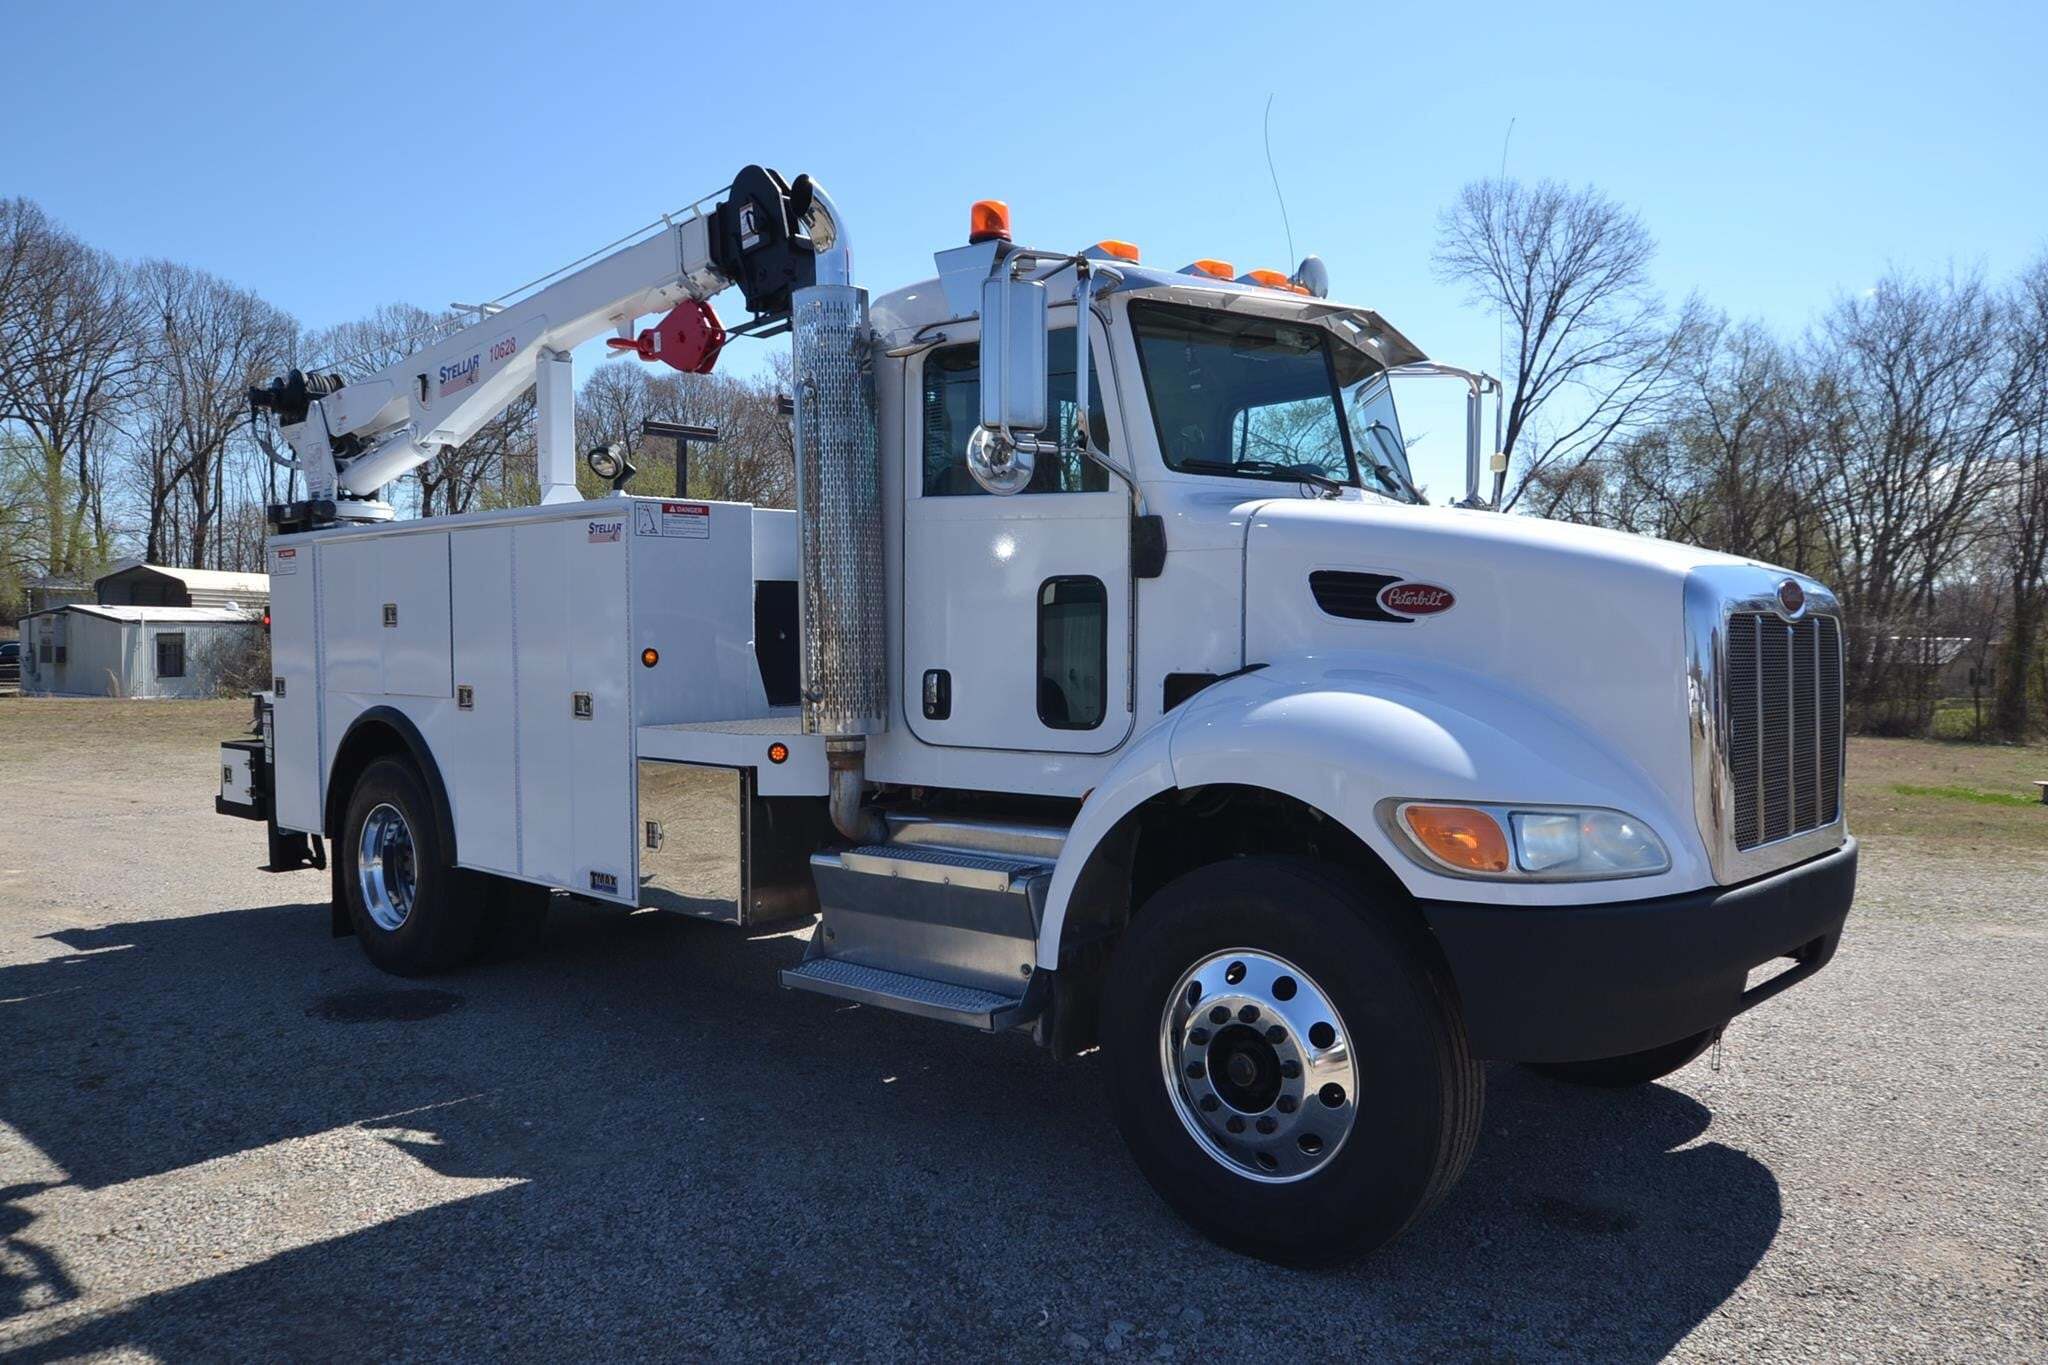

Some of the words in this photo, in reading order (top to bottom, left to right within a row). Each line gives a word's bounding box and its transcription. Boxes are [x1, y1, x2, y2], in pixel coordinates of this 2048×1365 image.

[440, 354, 479, 385] STELLAR
[489, 336, 516, 362] 10628
[588, 521, 622, 534] STELLAR
[1387, 588, 1448, 606] Peterbilt
